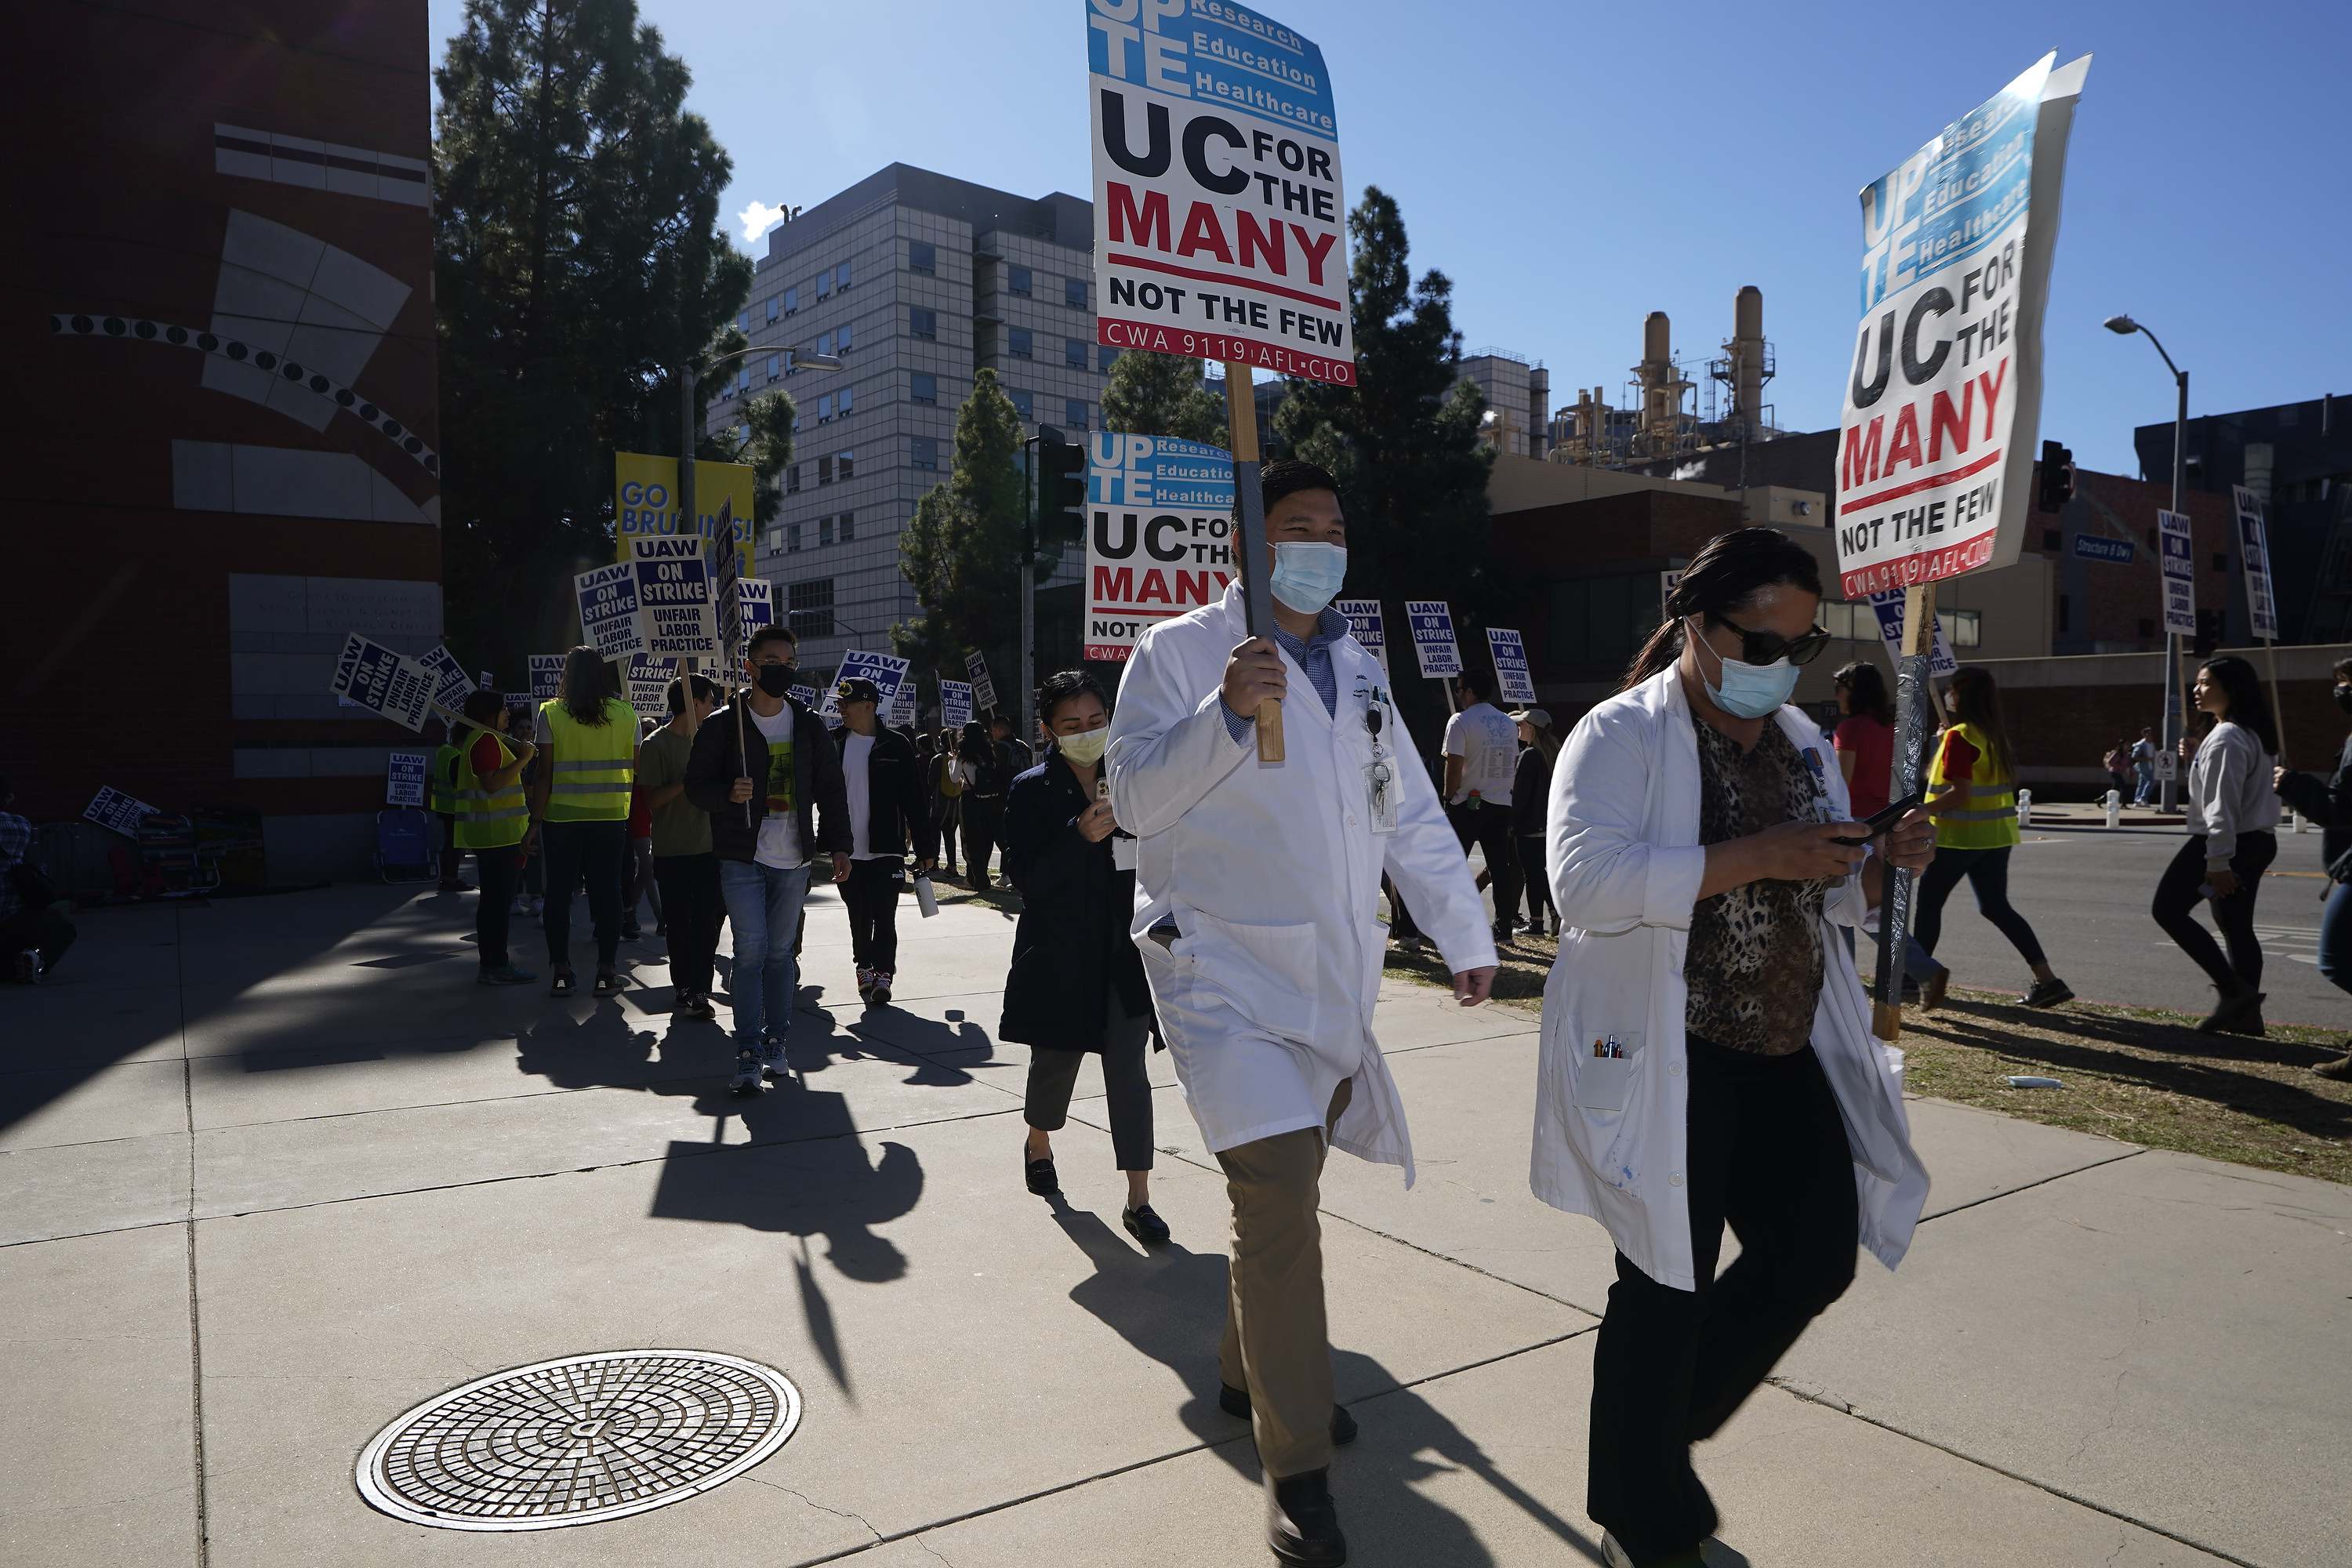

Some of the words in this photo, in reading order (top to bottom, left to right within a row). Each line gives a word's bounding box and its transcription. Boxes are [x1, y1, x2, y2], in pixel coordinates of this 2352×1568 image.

[1091, 20, 1191, 97] TE
[1193, 32, 1316, 88] Education
[1196, 71, 1333, 129] Healthcare
[1101, 89, 1250, 195] UC
[1253, 129, 1334, 182] FOR
[1254, 171, 1334, 223] THE
[1106, 181, 1337, 287] MANY
[1862, 219, 1921, 310] TE
[1960, 238, 2016, 316] FOR
[1110, 278, 1185, 314] NOT
[1197, 293, 1269, 329] THE
[1279, 308, 1343, 347] FEW
[1107, 324, 1168, 350] CWA
[1183, 334, 1245, 360] 9119
[1957, 298, 2009, 368] THE
[1853, 287, 1955, 409] UC
[1842, 355, 2009, 492] MANY
[1091, 434, 1153, 470] UP
[1157, 464, 1233, 480] Educatio
[621, 481, 669, 510] GO
[1091, 467, 1152, 506] TE
[1156, 488, 1235, 503] Healthca
[714, 500, 731, 543] UAW
[1842, 517, 1883, 557] NOT
[1891, 500, 1947, 543] THE
[1954, 477, 1998, 528] FEW
[2161, 513, 2187, 534] UAW
[1094, 511, 1188, 562] UC
[1192, 517, 1229, 539] FO
[636, 539, 698, 558] UAW
[1192, 544, 1229, 564] TH
[2077, 539, 2108, 555] Structure
[2117, 545, 2132, 561] Dwy
[2171, 537, 2183, 555] ON
[657, 562, 684, 581] ON
[2164, 555, 2191, 576] STRIKE
[580, 564, 630, 589] UAW
[1845, 571, 1878, 596] CWA
[287, 590, 329, 601] GONDA
[597, 584, 618, 602] ON
[643, 582, 706, 601] STRIKE
[739, 583, 768, 599] AW
[259, 603, 351, 615] NEUROSCIENCE
[374, 608, 432, 617] GENETICS
[584, 596, 636, 621] STRIKE
[653, 608, 701, 622] UNFAIR
[1340, 603, 1378, 614] UAW
[1410, 603, 1445, 613] UAW
[326, 619, 384, 630] RESEARCH
[390, 621, 432, 631] CENTER
[593, 616, 633, 636] UNFAIR
[658, 623, 701, 637] LABOR
[1092, 620, 1139, 637] NOT
[1353, 618, 1370, 630] ON
[1424, 616, 1439, 628] ON
[597, 628, 632, 647] LABOR
[1350, 631, 1382, 643] TRIKE
[1416, 629, 1453, 641] STRIKE
[1489, 630, 1519, 643] UAW
[597, 637, 642, 658] RACTICE
[650, 637, 713, 652] PRACTICE
[1090, 646, 1127, 659] CWA
[1423, 645, 1452, 654] UNFAIR
[1502, 646, 1515, 657] ON
[335, 637, 361, 691] UAW
[419, 648, 445, 667] AW
[848, 652, 907, 671] UAW
[967, 652, 982, 667] UAW
[1428, 655, 1453, 663] LABOR
[1496, 657, 1526, 670] STRIKE
[356, 660, 375, 685] ON
[630, 666, 673, 680] STRIKE
[859, 667, 883, 679] ON
[974, 666, 981, 675] ON
[1423, 664, 1460, 673] PRACTICE
[1503, 671, 1526, 681] UNFAIR
[365, 652, 395, 706] STRIKE
[544, 673, 561, 684] ON
[944, 681, 971, 691] UAW
[973, 672, 989, 688] STRIKE
[1506, 681, 1527, 690] LABOR
[387, 668, 409, 710] UNFAIR
[398, 676, 420, 713] LABOR
[437, 684, 467, 706] UNFAIR
[533, 684, 559, 696] STRI
[631, 693, 660, 702] LABOR
[632, 684, 665, 693] UNFAIR
[789, 685, 815, 695] UAW
[952, 691, 963, 699] ON
[977, 683, 990, 694] UNFAIR
[979, 691, 992, 700] LABOR
[1503, 690, 1534, 699] PRACTICE
[408, 672, 434, 727] PRACTICE
[445, 692, 469, 710] ABOR
[630, 702, 665, 712] RACTICE
[944, 698, 971, 708] STRIKE
[980, 695, 996, 707] PRACTICE
[1824, 706, 1837, 717] 731
[393, 754, 424, 764] UAW
[391, 772, 423, 782] STRIKE
[401, 764, 414, 773] ON
[86, 787, 113, 818] UAW
[104, 801, 118, 815] ON
[108, 797, 133, 827] STRIKE
[121, 805, 141, 828] UNFAIR
